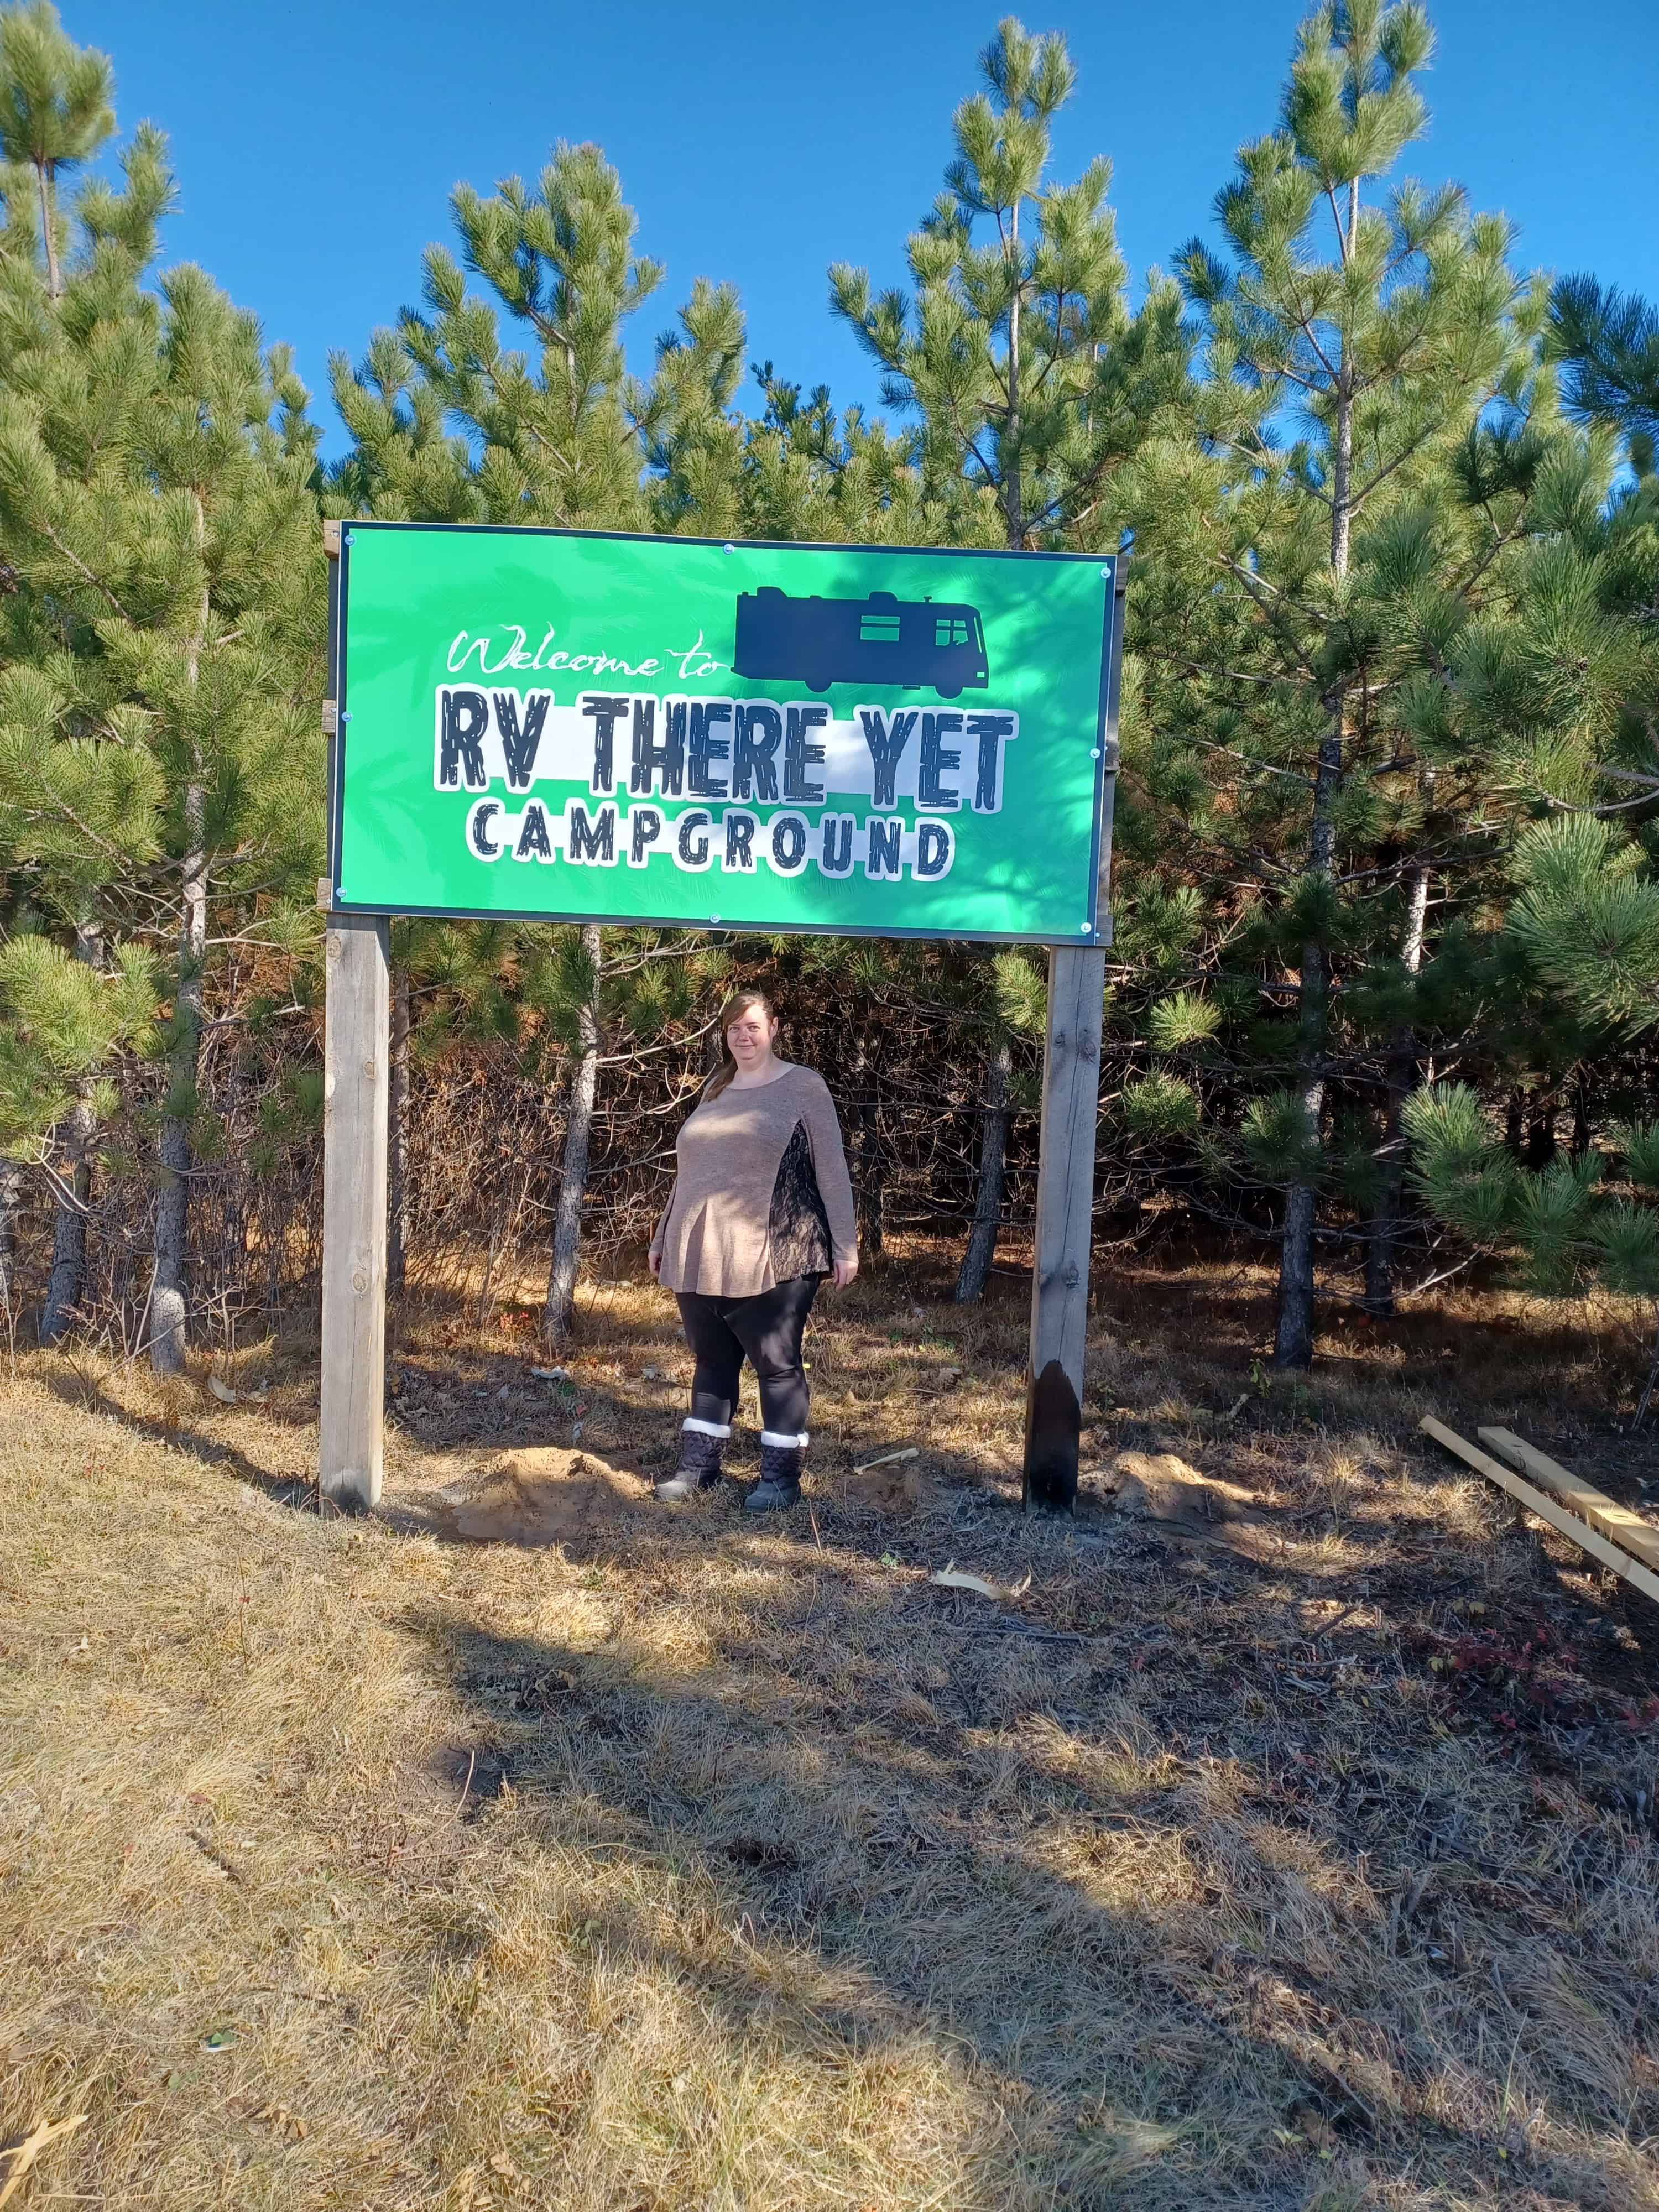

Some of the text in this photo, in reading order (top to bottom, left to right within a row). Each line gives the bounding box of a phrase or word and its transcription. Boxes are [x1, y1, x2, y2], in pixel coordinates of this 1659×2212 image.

[447, 622, 731, 679] Welcome to
[440, 690, 1014, 810] RV THERE YET
[473, 804, 950, 875] CAMPGROUND
